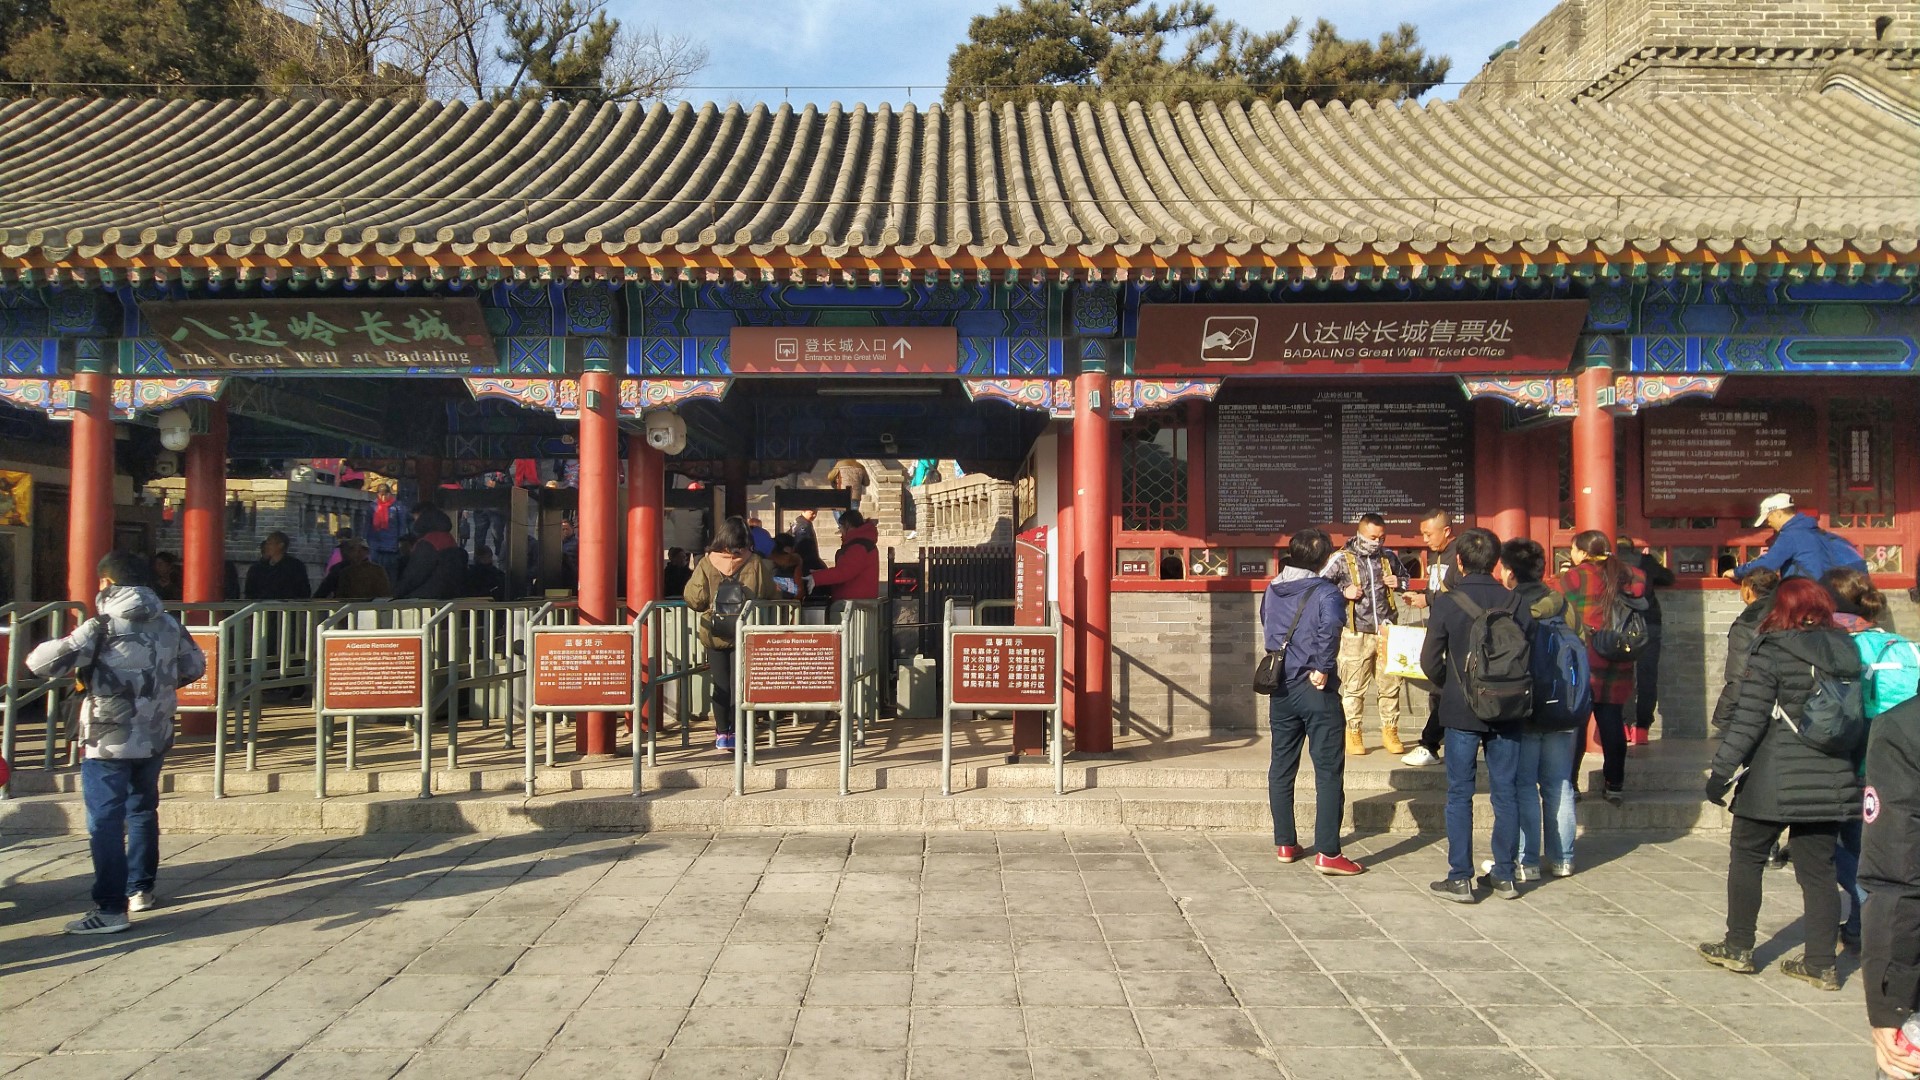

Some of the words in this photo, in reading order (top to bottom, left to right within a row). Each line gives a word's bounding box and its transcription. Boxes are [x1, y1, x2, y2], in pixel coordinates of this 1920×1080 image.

[170, 308, 465, 346] 八达岭长城
[1284, 319, 1514, 344] 八达岭长城售票处
[805, 338, 887, 353] 登长城入口
[1283, 348, 1355, 358] BADALING
[1358, 348, 1393, 357] Great
[1396, 347, 1423, 357] Wall
[1428, 347, 1466, 357] Ticket
[1468, 346, 1505, 356] Office
[180, 353, 216, 365] The
[229, 352, 282, 365] Great
[296, 351, 340, 364] Wall
[352, 352, 372, 363] at
[386, 351, 470, 364] Badaling
[1201, 548, 1210, 562] 1
[1876, 546, 1886, 560] 6
[565, 638, 603, 647] 温馨提示
[985, 638, 1023, 646] 温馨提示
[963, 664, 1000, 672] 城上公厕少
[1008, 664, 1045, 672] 方便在城下
